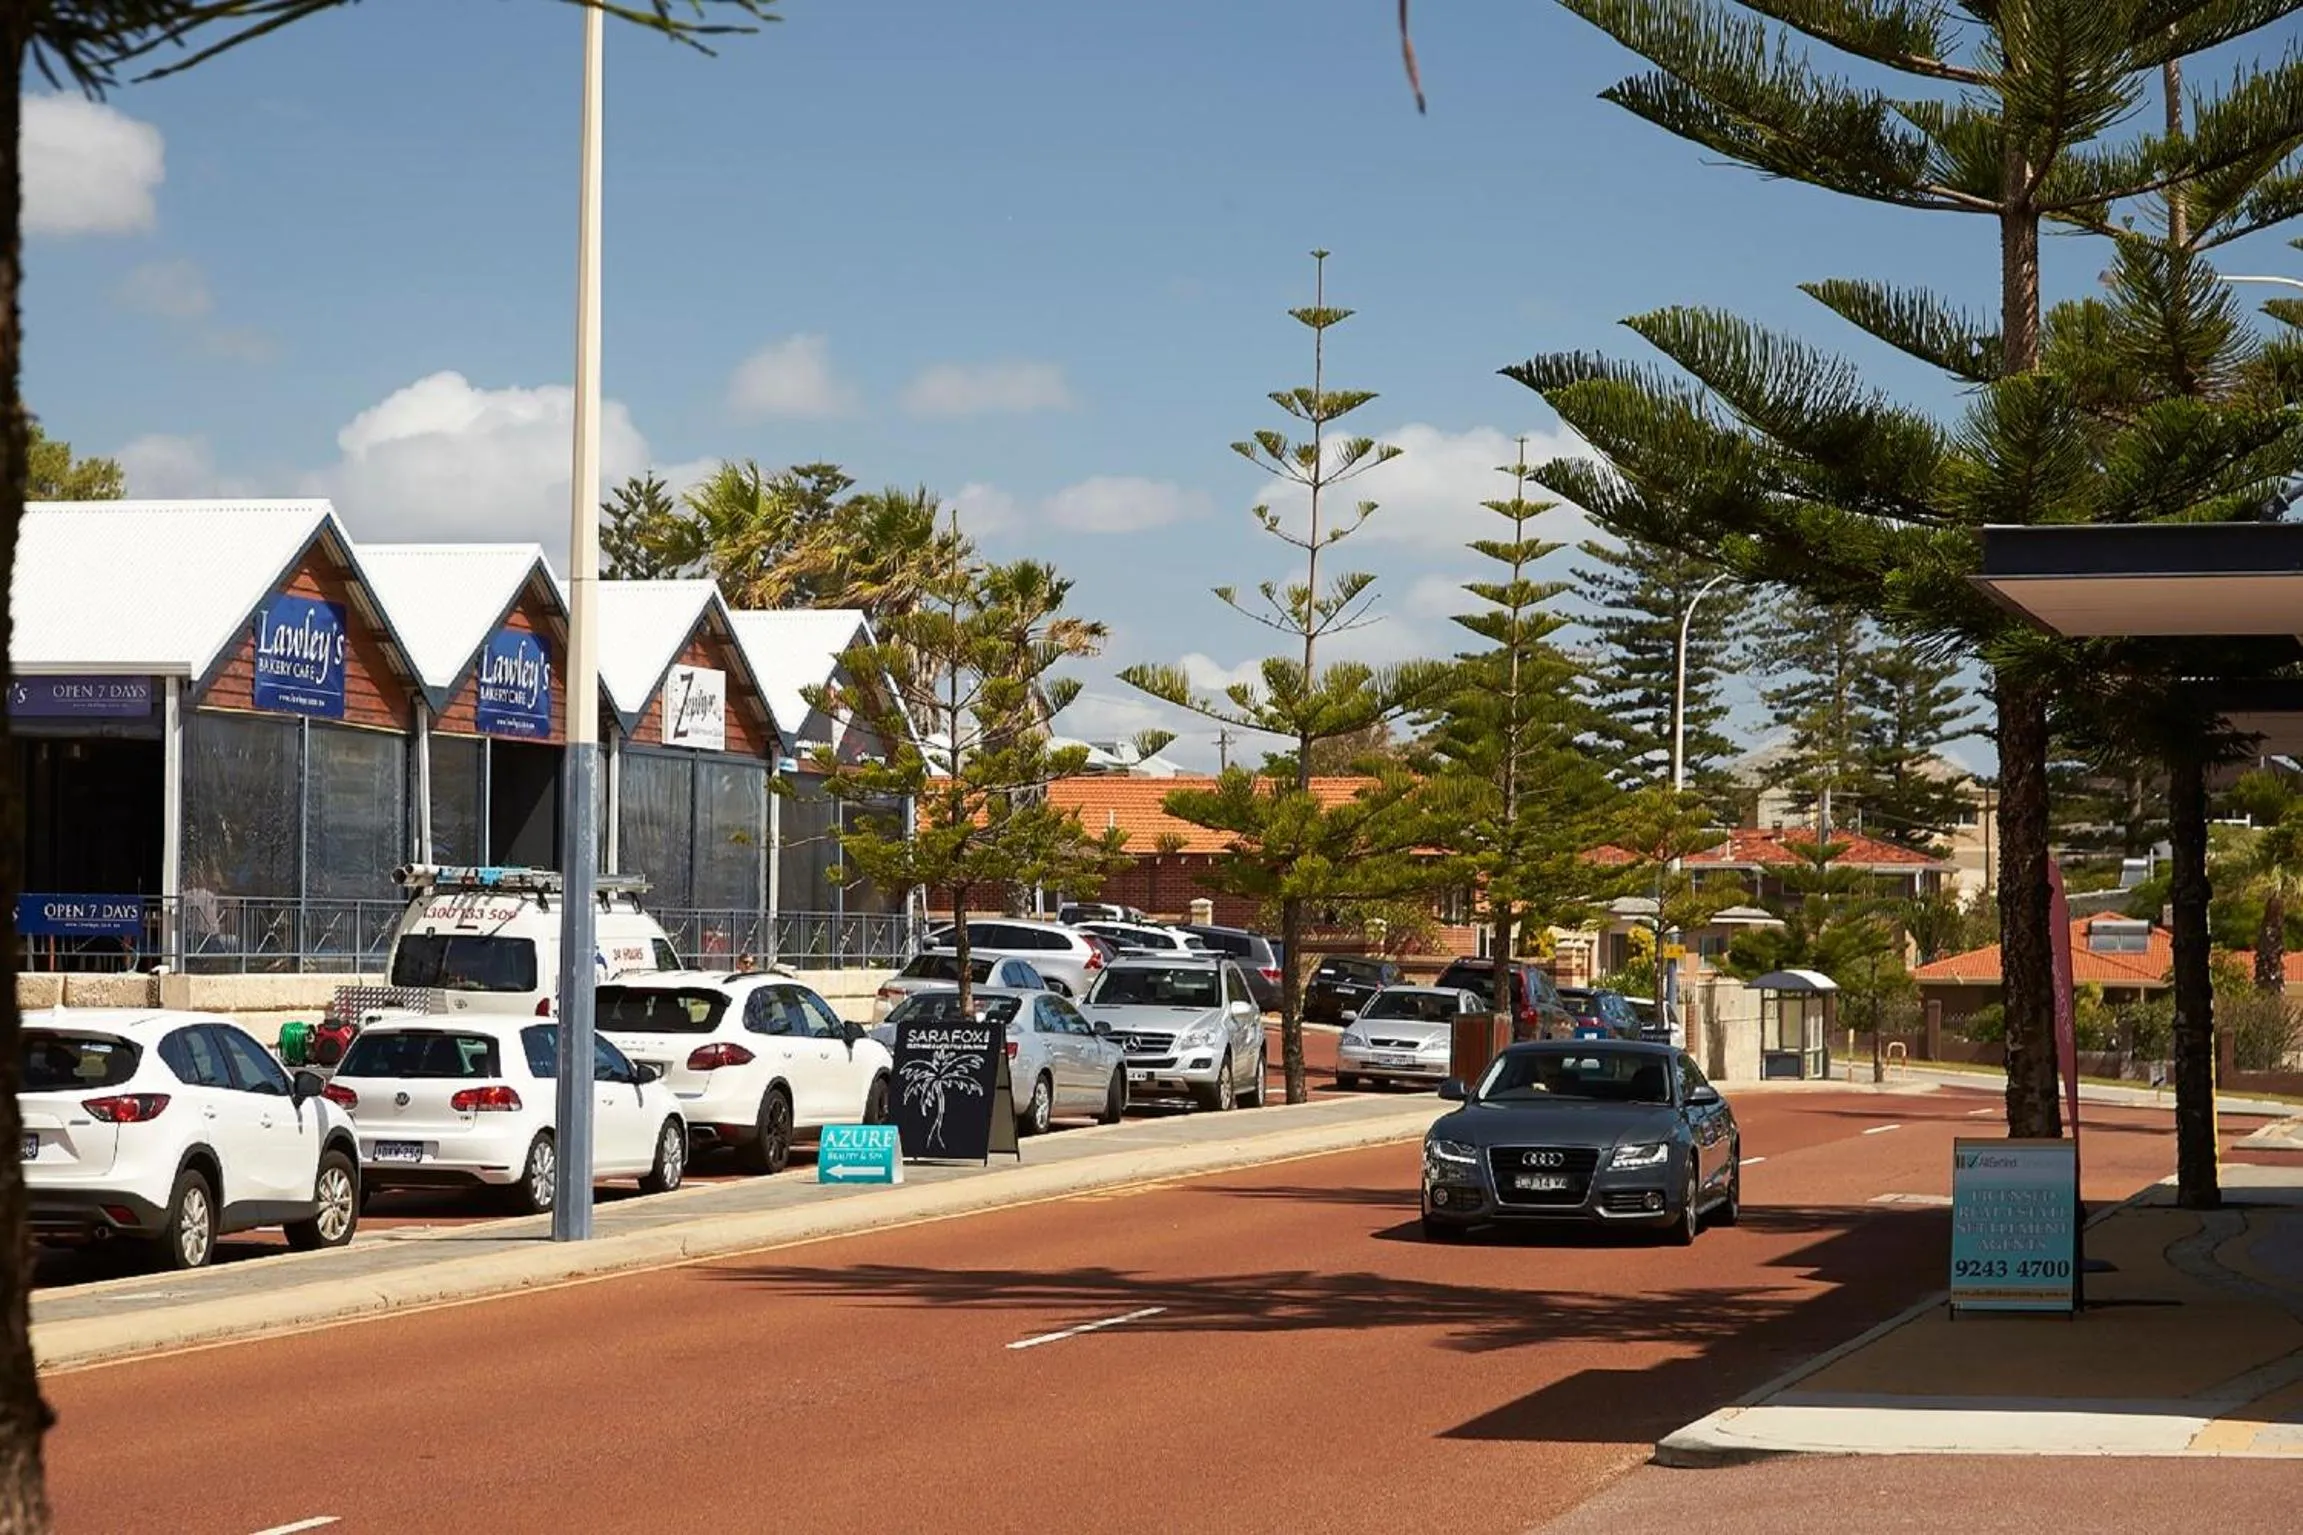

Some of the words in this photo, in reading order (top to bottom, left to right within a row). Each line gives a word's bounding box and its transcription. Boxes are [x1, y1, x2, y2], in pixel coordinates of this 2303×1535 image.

[258, 608, 344, 685] Lawley's
[258, 657, 292, 676] BAKERY
[480, 640, 551, 709] Lawley's
[52, 684, 93, 699] OPEN
[98, 684, 106, 699] 7
[109, 684, 147, 699] DAYS
[43, 902, 84, 919] OPEN
[90, 904, 98, 918] 7
[102, 904, 138, 919] DAYS
[823, 1129, 894, 1148] AZURE
[1955, 1259, 2008, 1278] 9243
[2016, 1259, 2071, 1278] 4700
